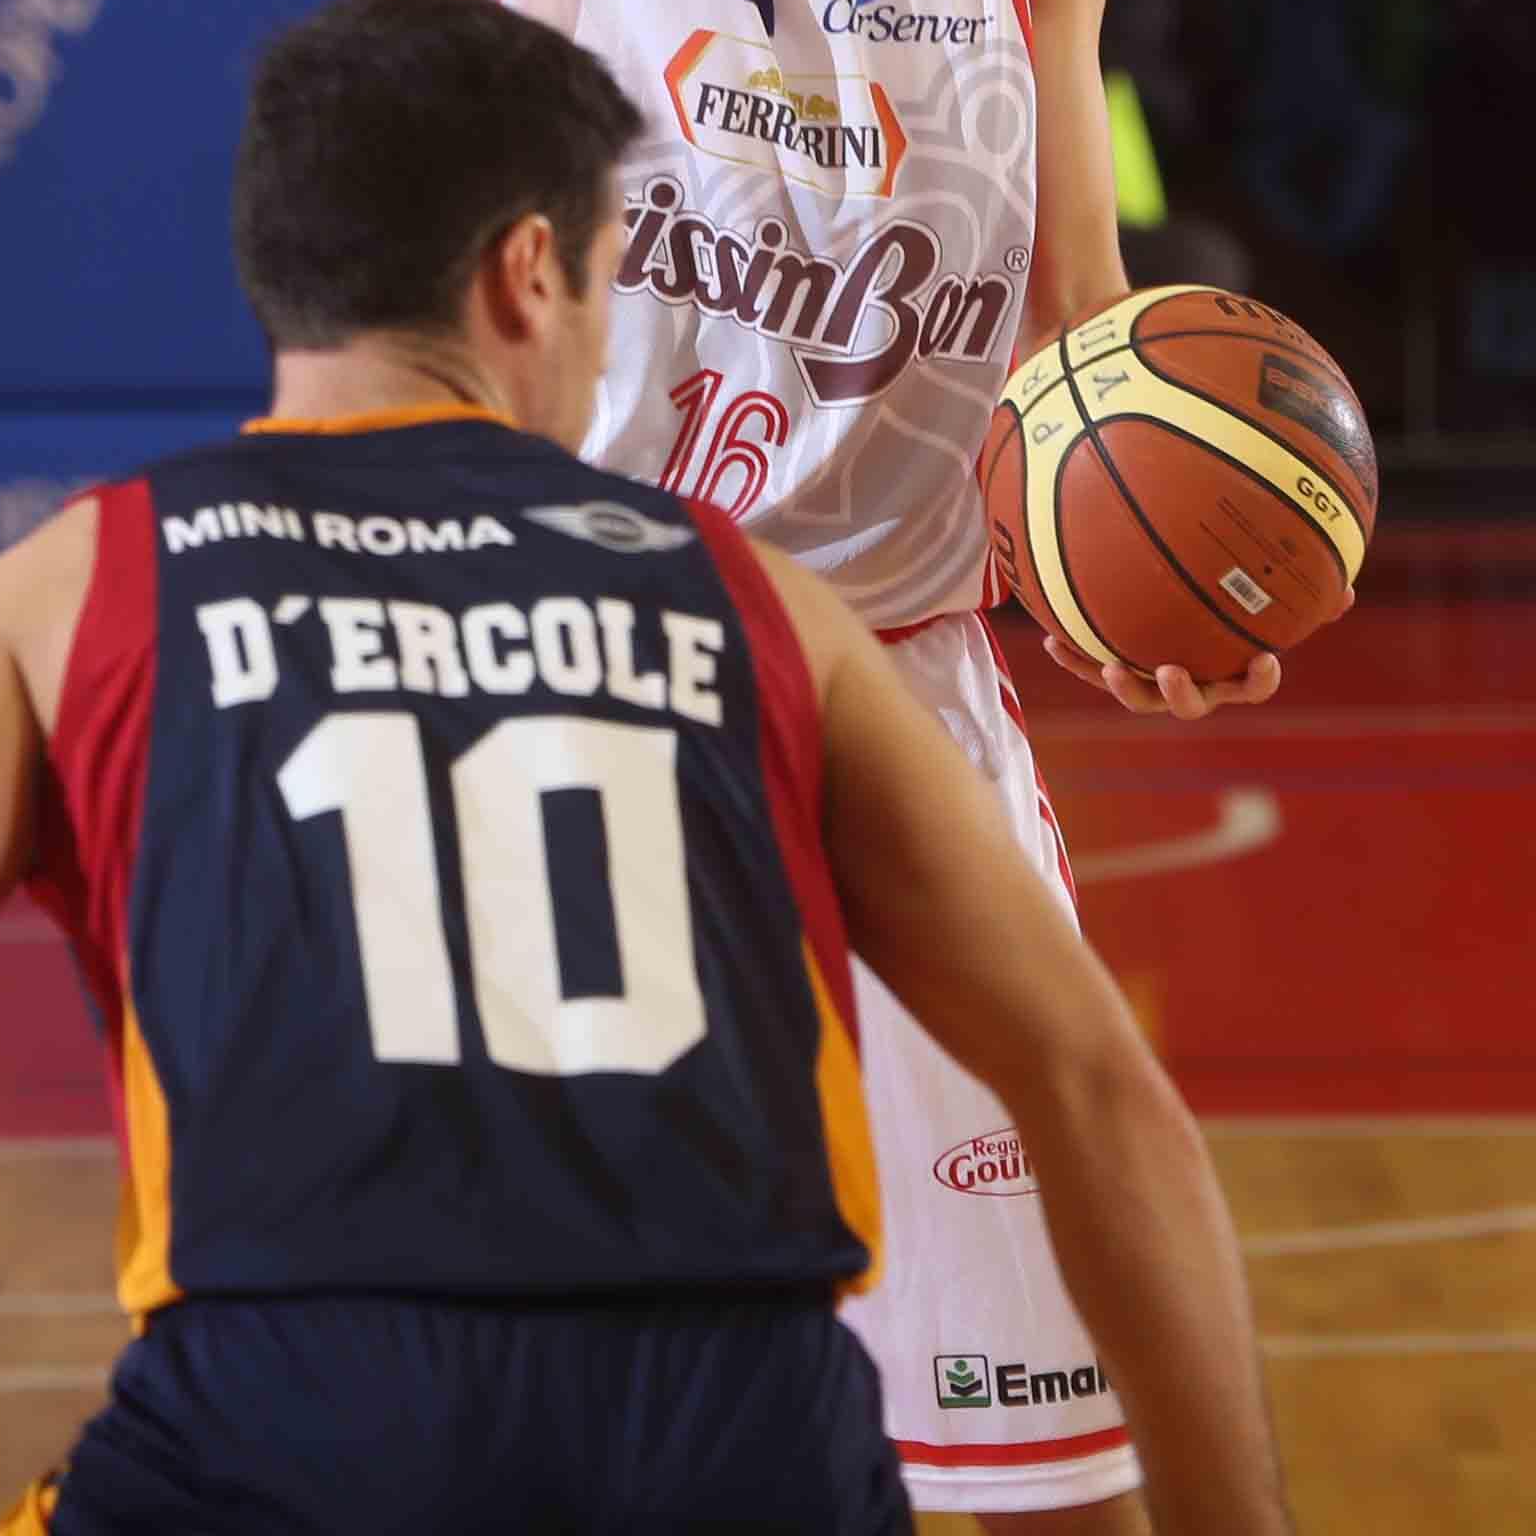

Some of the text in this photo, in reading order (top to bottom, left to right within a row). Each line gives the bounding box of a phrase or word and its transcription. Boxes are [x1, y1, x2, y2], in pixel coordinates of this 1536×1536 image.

[695, 82, 882, 169] FERRARINI
[658, 368, 790, 520] 16
[163, 502, 516, 556] MINI ROMA
[1295, 475, 1344, 524] GG7
[275, 710, 709, 1077] 10
[972, 1139, 1025, 1159] Regg
